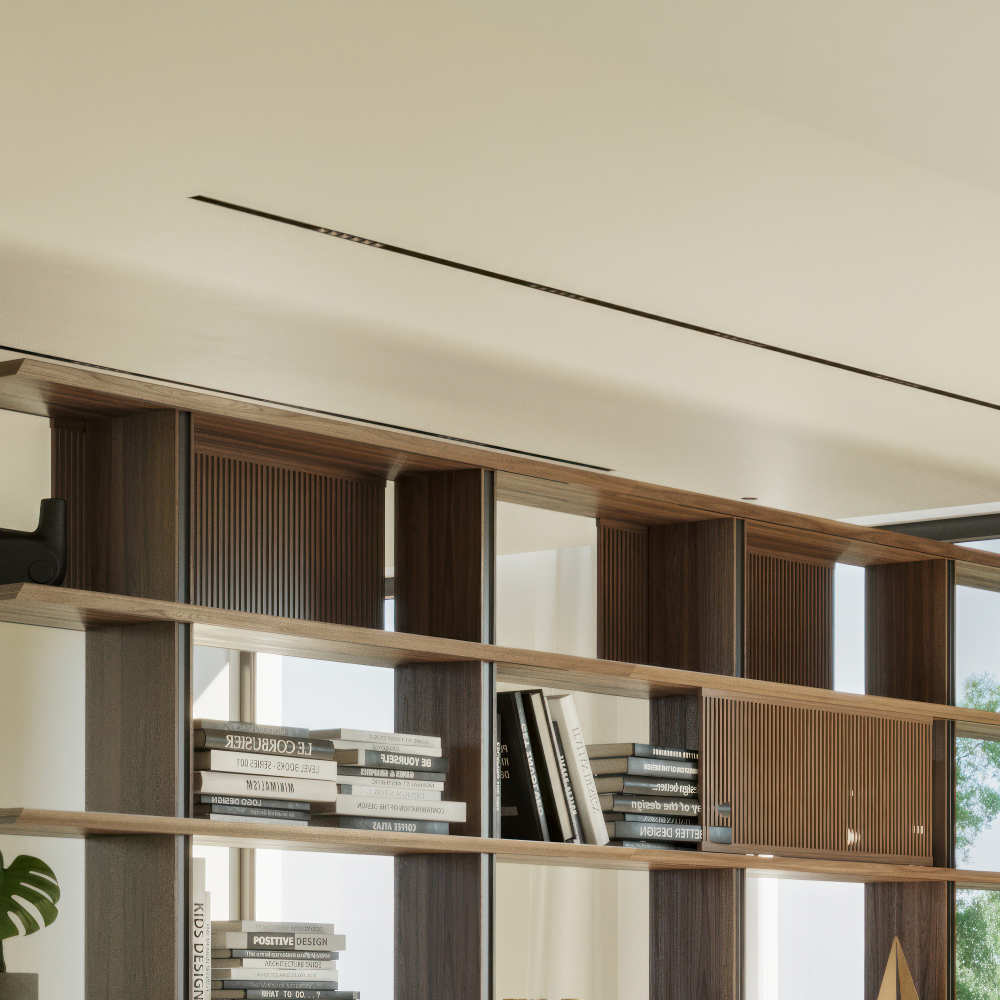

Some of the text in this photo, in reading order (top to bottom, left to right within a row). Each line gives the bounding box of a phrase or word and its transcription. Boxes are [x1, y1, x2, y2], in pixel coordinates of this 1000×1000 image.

[253, 936, 328, 947] POSITIVE DESIGN
[193, 902, 204, 1000] KIDS DESIGN
[261, 990, 280, 998] WHAT
